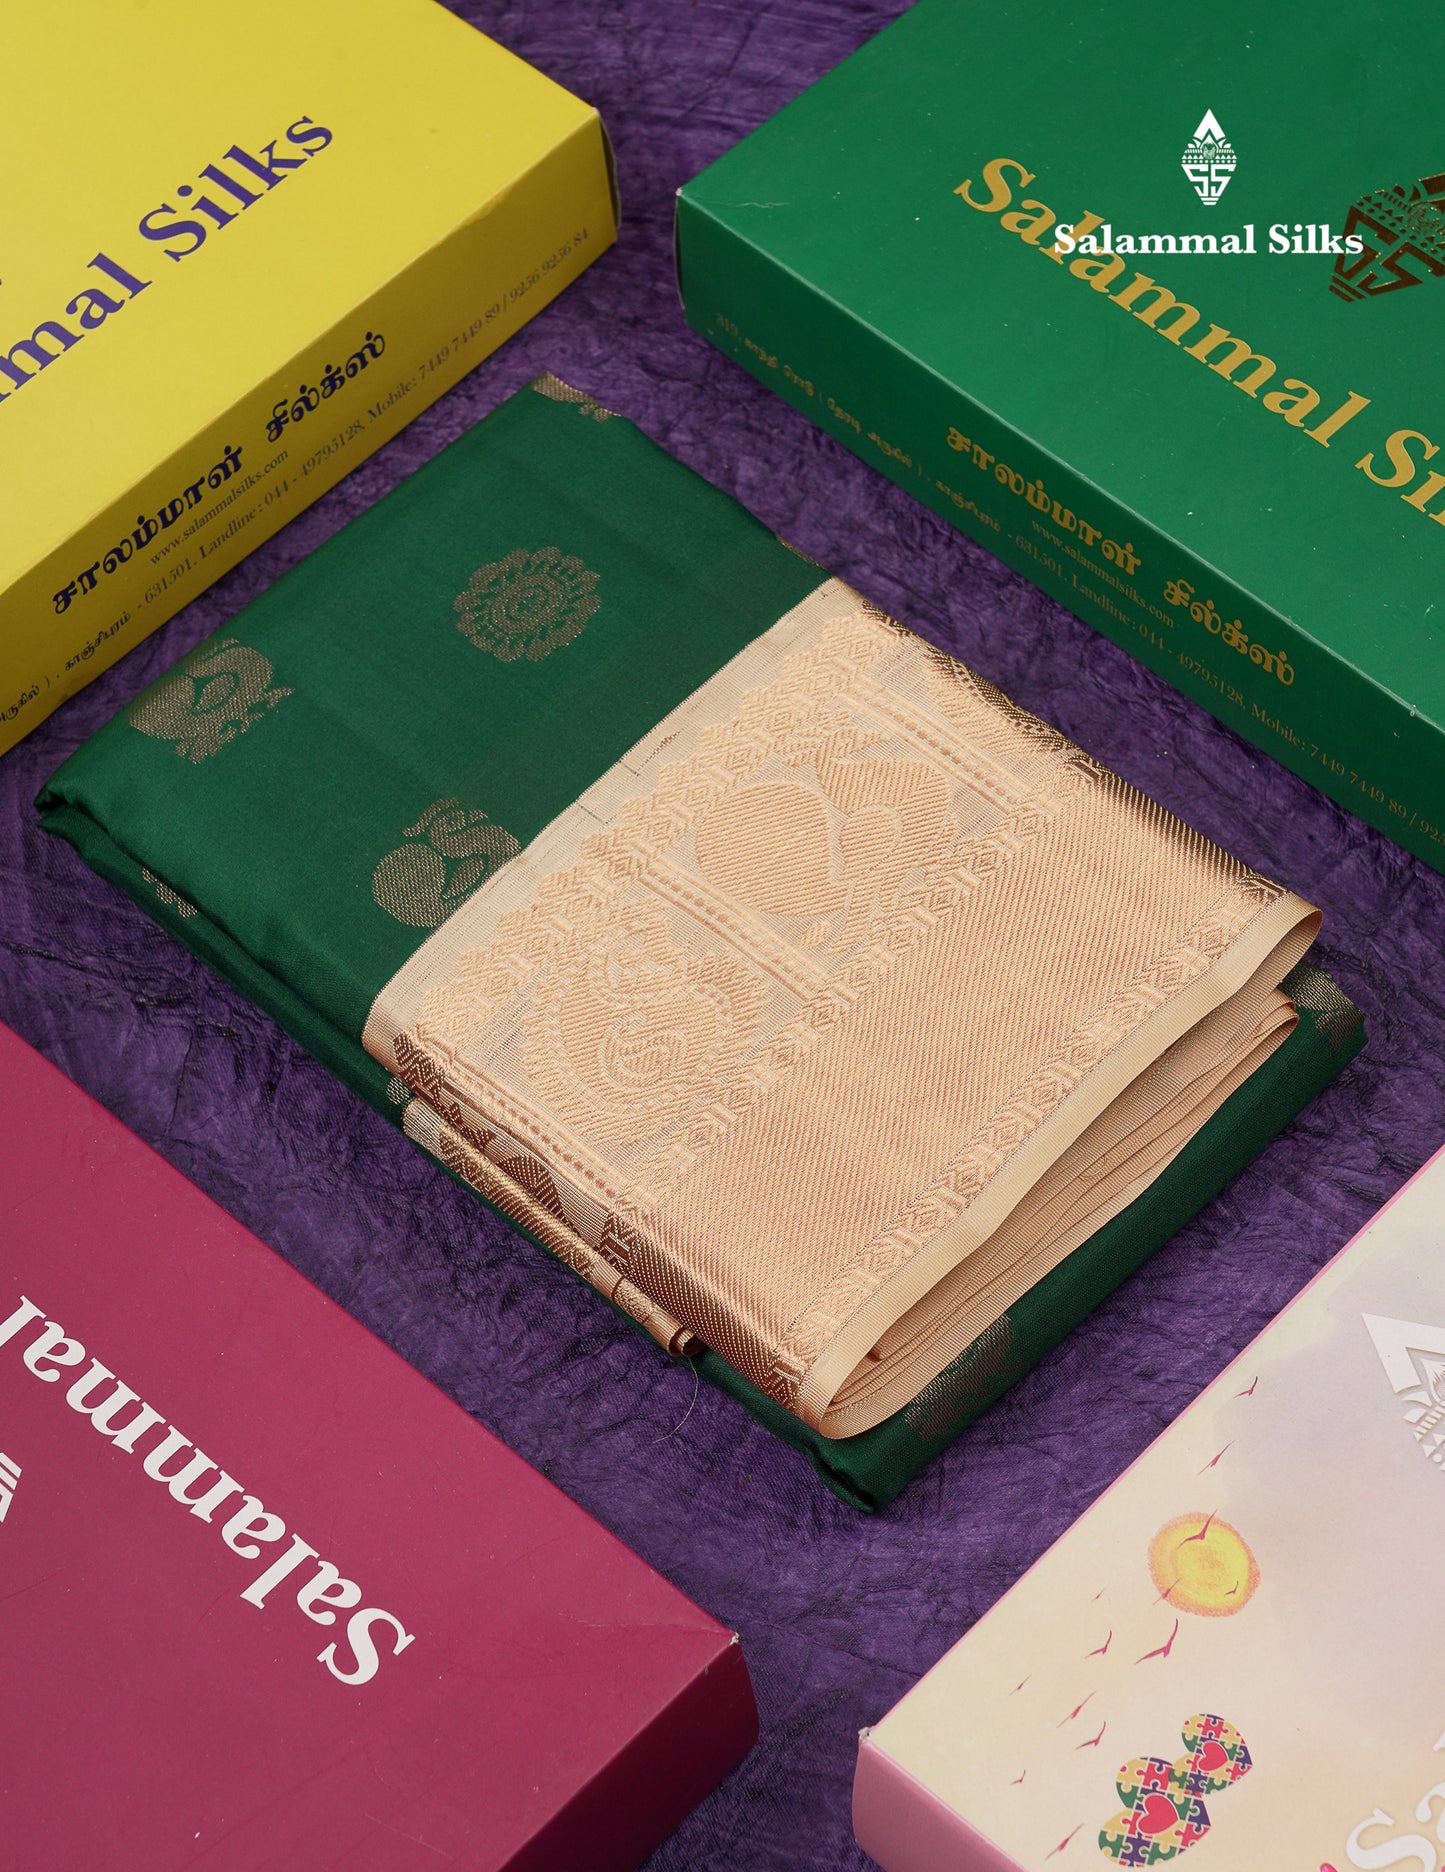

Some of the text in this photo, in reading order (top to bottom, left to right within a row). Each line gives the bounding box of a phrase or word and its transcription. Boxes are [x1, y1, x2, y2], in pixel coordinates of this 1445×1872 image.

[138, 115, 334, 263] Silks
[952, 157, 1372, 449] Salammal
[52, 331, 386, 615] சாலம்மாள் சில்க்ஸ்
[149, 450, 289, 566] www.salammalsilks.com
[945, 426, 1295, 687] சாலம்மாள் சில்க்ஸ்
[1031, 519, 1175, 629] www.salammalsilks.com
